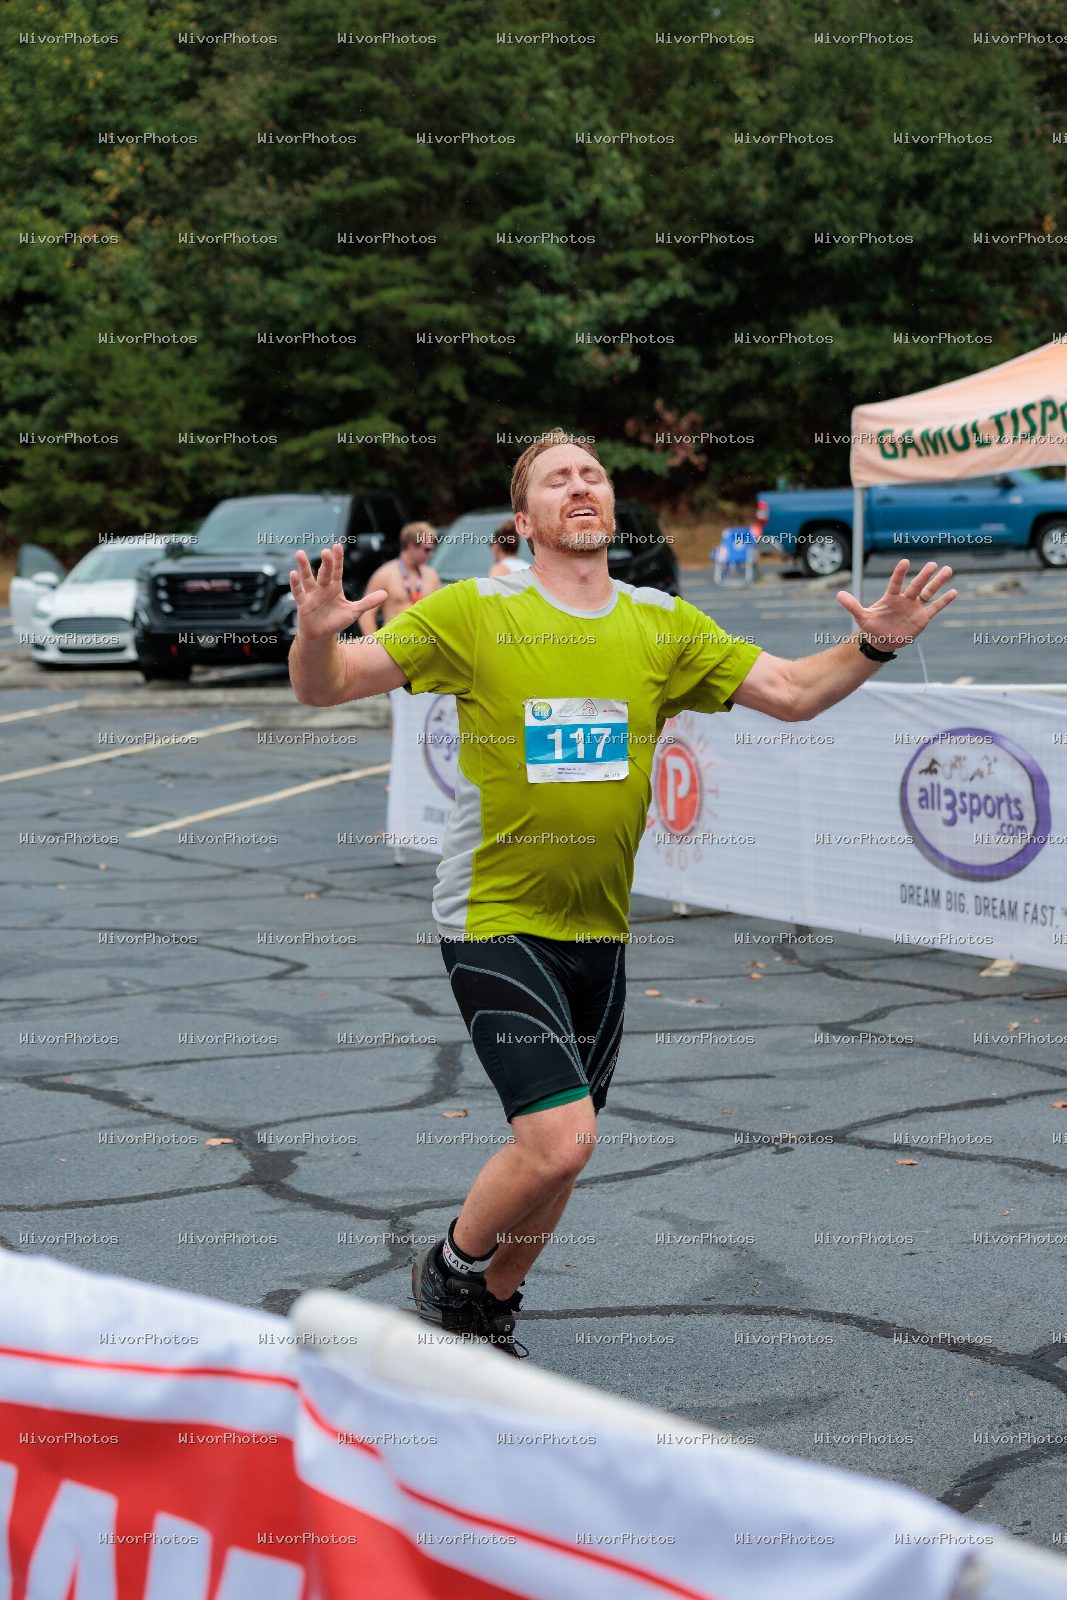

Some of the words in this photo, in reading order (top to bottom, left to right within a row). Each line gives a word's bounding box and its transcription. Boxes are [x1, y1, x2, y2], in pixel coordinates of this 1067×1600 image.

[547, 727, 611, 760] 117
[918, 783, 1024, 826] all3sports
[996, 821, 1028, 838] .com
[900, 883, 941, 910] DREAM
[946, 891, 969, 915] BIG.
[974, 896, 1018, 922] DREAM
[1023, 902, 1059, 928] FAST.
